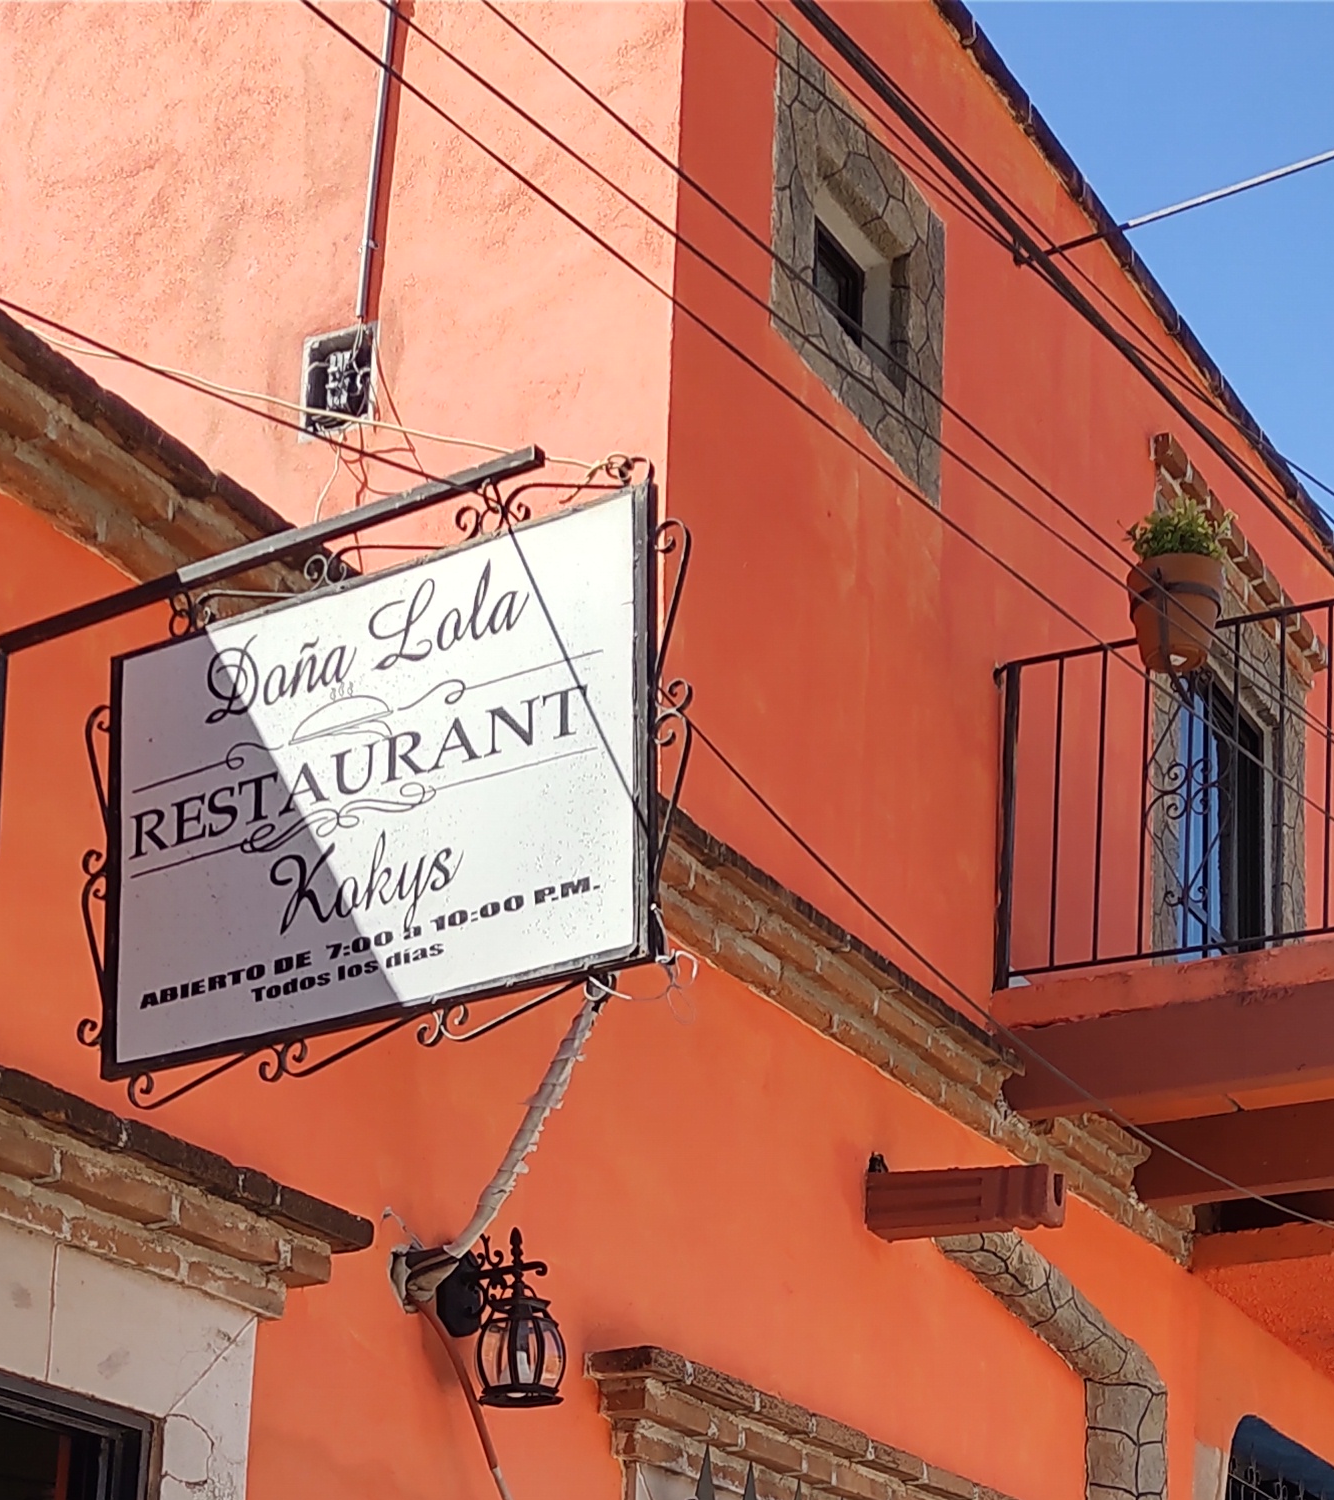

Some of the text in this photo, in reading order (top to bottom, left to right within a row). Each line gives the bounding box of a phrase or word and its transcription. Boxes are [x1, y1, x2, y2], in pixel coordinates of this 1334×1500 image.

[205, 557, 530, 725] Doña Lola
[128, 684, 588, 865] RESTAURANT
[140, 963, 266, 1010] ABIERTO
[273, 950, 313, 976] DE
[325, 930, 394, 961] 7:00
[429, 894, 525, 932] 10:00
[533, 876, 601, 905] P.M.
[269, 830, 464, 936] Kokys
[250, 943, 445, 1003] Todos los días
